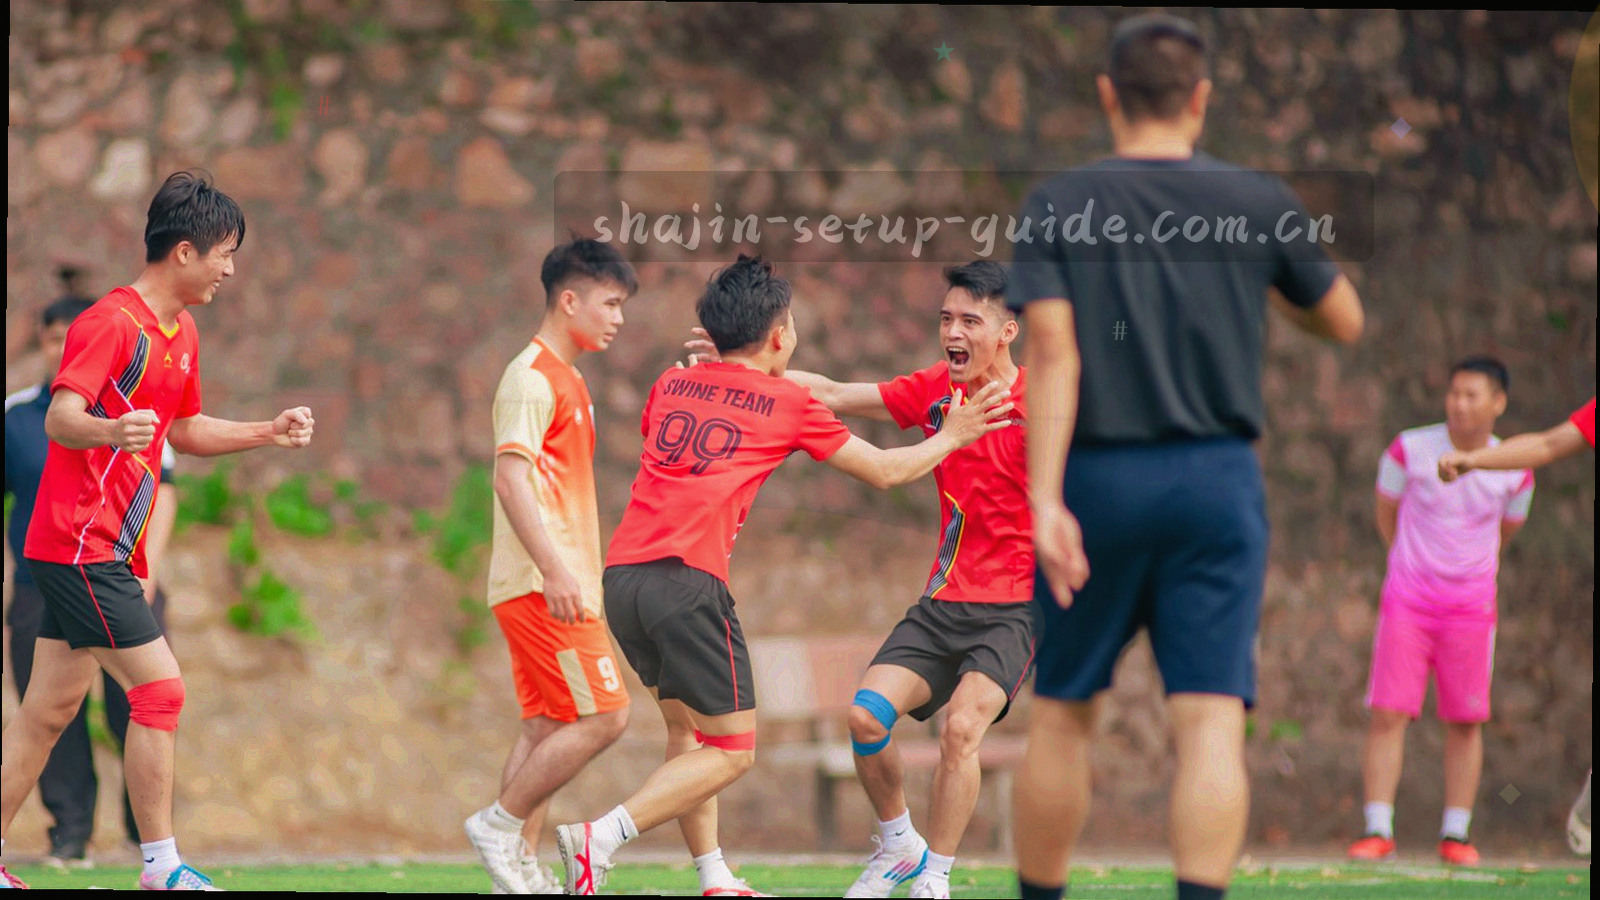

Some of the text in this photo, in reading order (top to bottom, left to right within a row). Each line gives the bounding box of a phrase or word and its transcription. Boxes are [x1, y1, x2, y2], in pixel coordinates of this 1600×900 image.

[663, 379, 775, 417] SWINE TEAM
[656, 410, 742, 475] 99
[596, 655, 620, 692] 9
